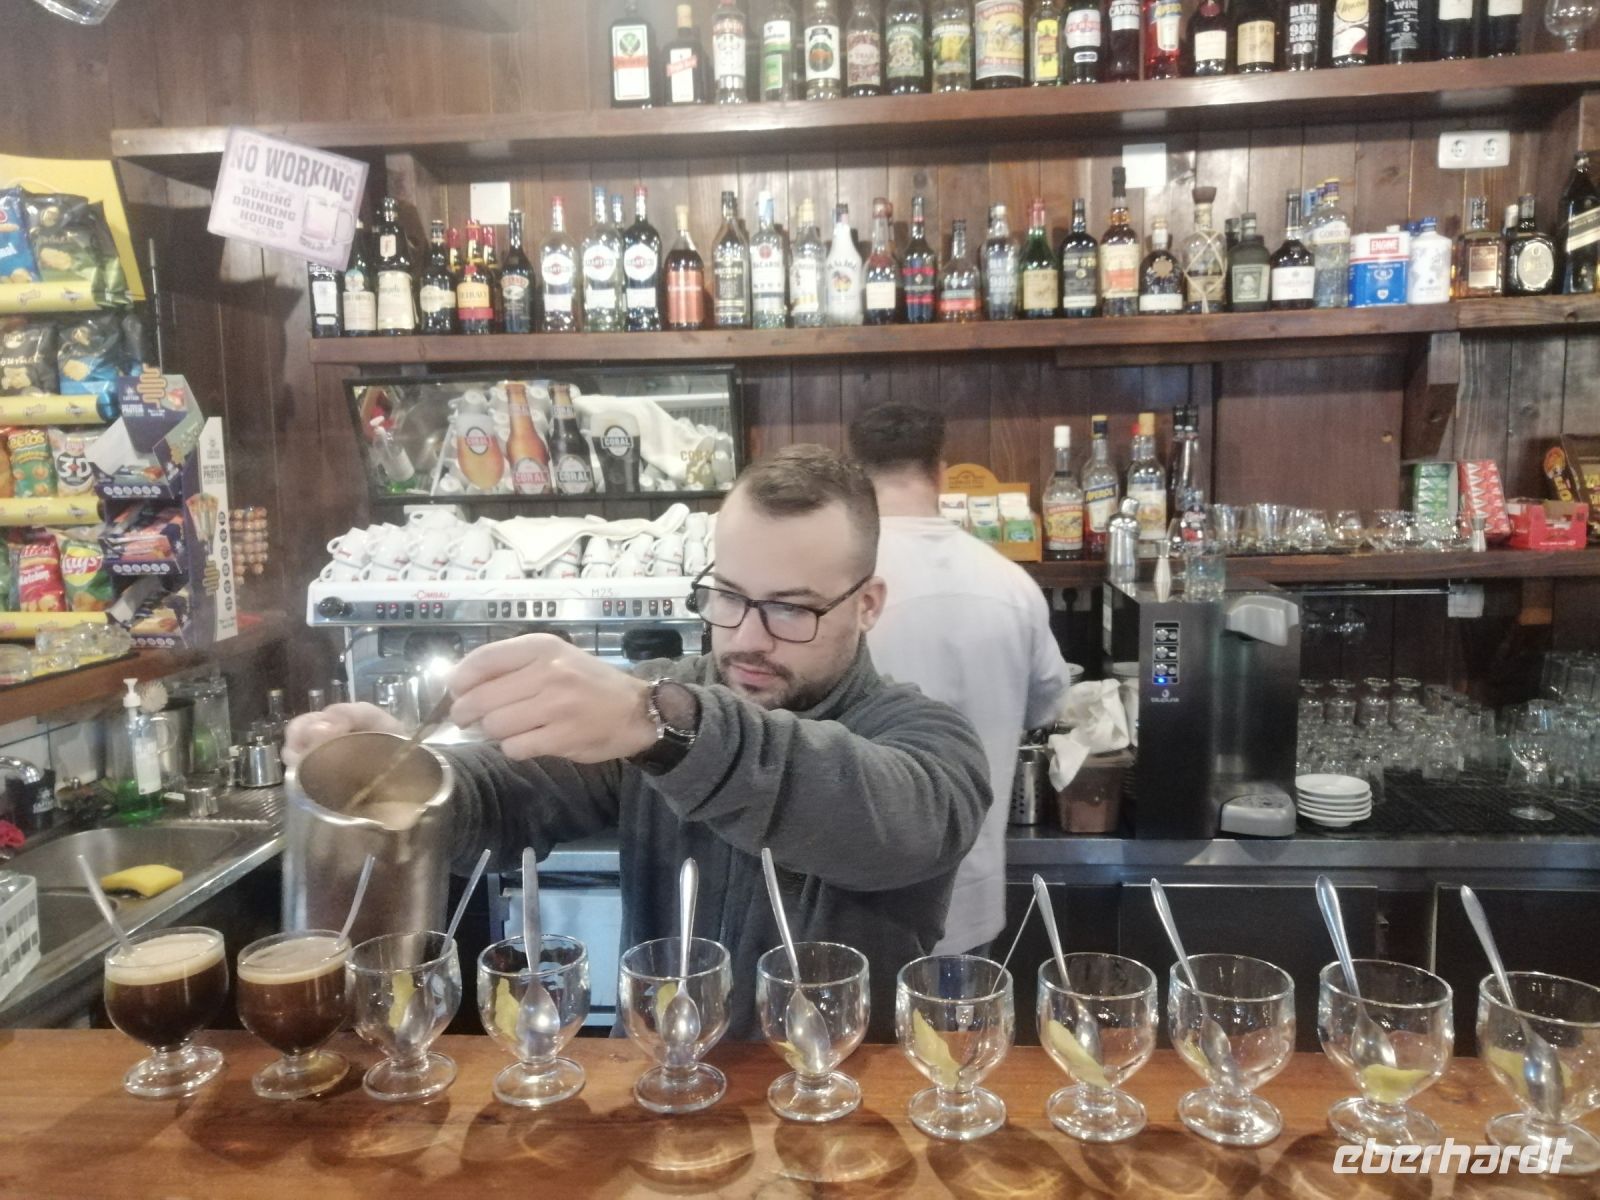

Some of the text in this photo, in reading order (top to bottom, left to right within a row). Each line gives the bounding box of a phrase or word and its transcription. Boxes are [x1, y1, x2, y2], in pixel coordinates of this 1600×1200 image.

[1289, 22, 1317, 36] 980
[231, 143, 356, 202] NO WORKING
[242, 185, 292, 208] DURING
[233, 195, 297, 222] DRINKING
[239, 210, 285, 231] HOURS
[604, 437, 631, 447] CORAL
[515, 471, 548, 483] CORAL
[558, 471, 590, 482] CORAL
